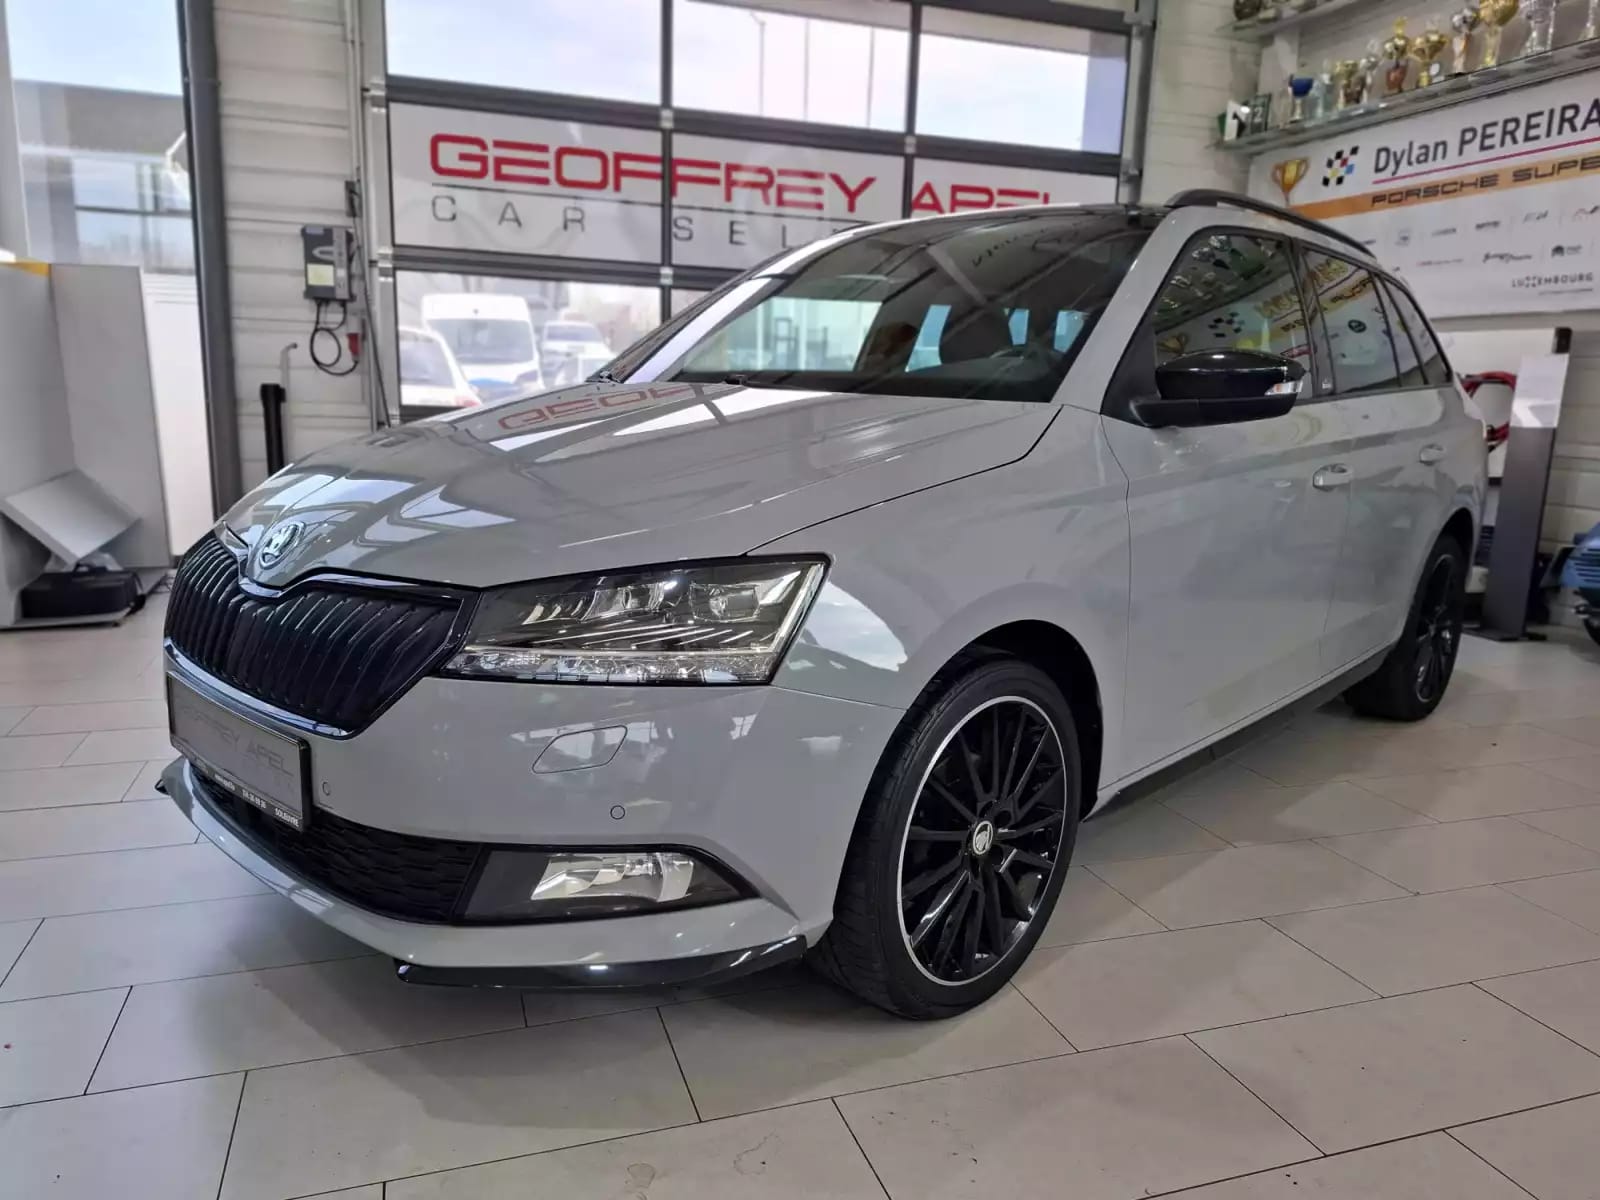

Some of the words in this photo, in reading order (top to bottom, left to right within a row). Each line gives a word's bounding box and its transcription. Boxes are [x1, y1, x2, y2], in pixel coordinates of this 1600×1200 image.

[1373, 139, 1448, 175] Dylan
[1458, 98, 1600, 155] PEREIRA
[430, 133, 877, 213] GEOFFREY
[1371, 173, 1500, 207] PORSCHE
[431, 195, 586, 233] CAR
[672, 215, 840, 249] SEL
